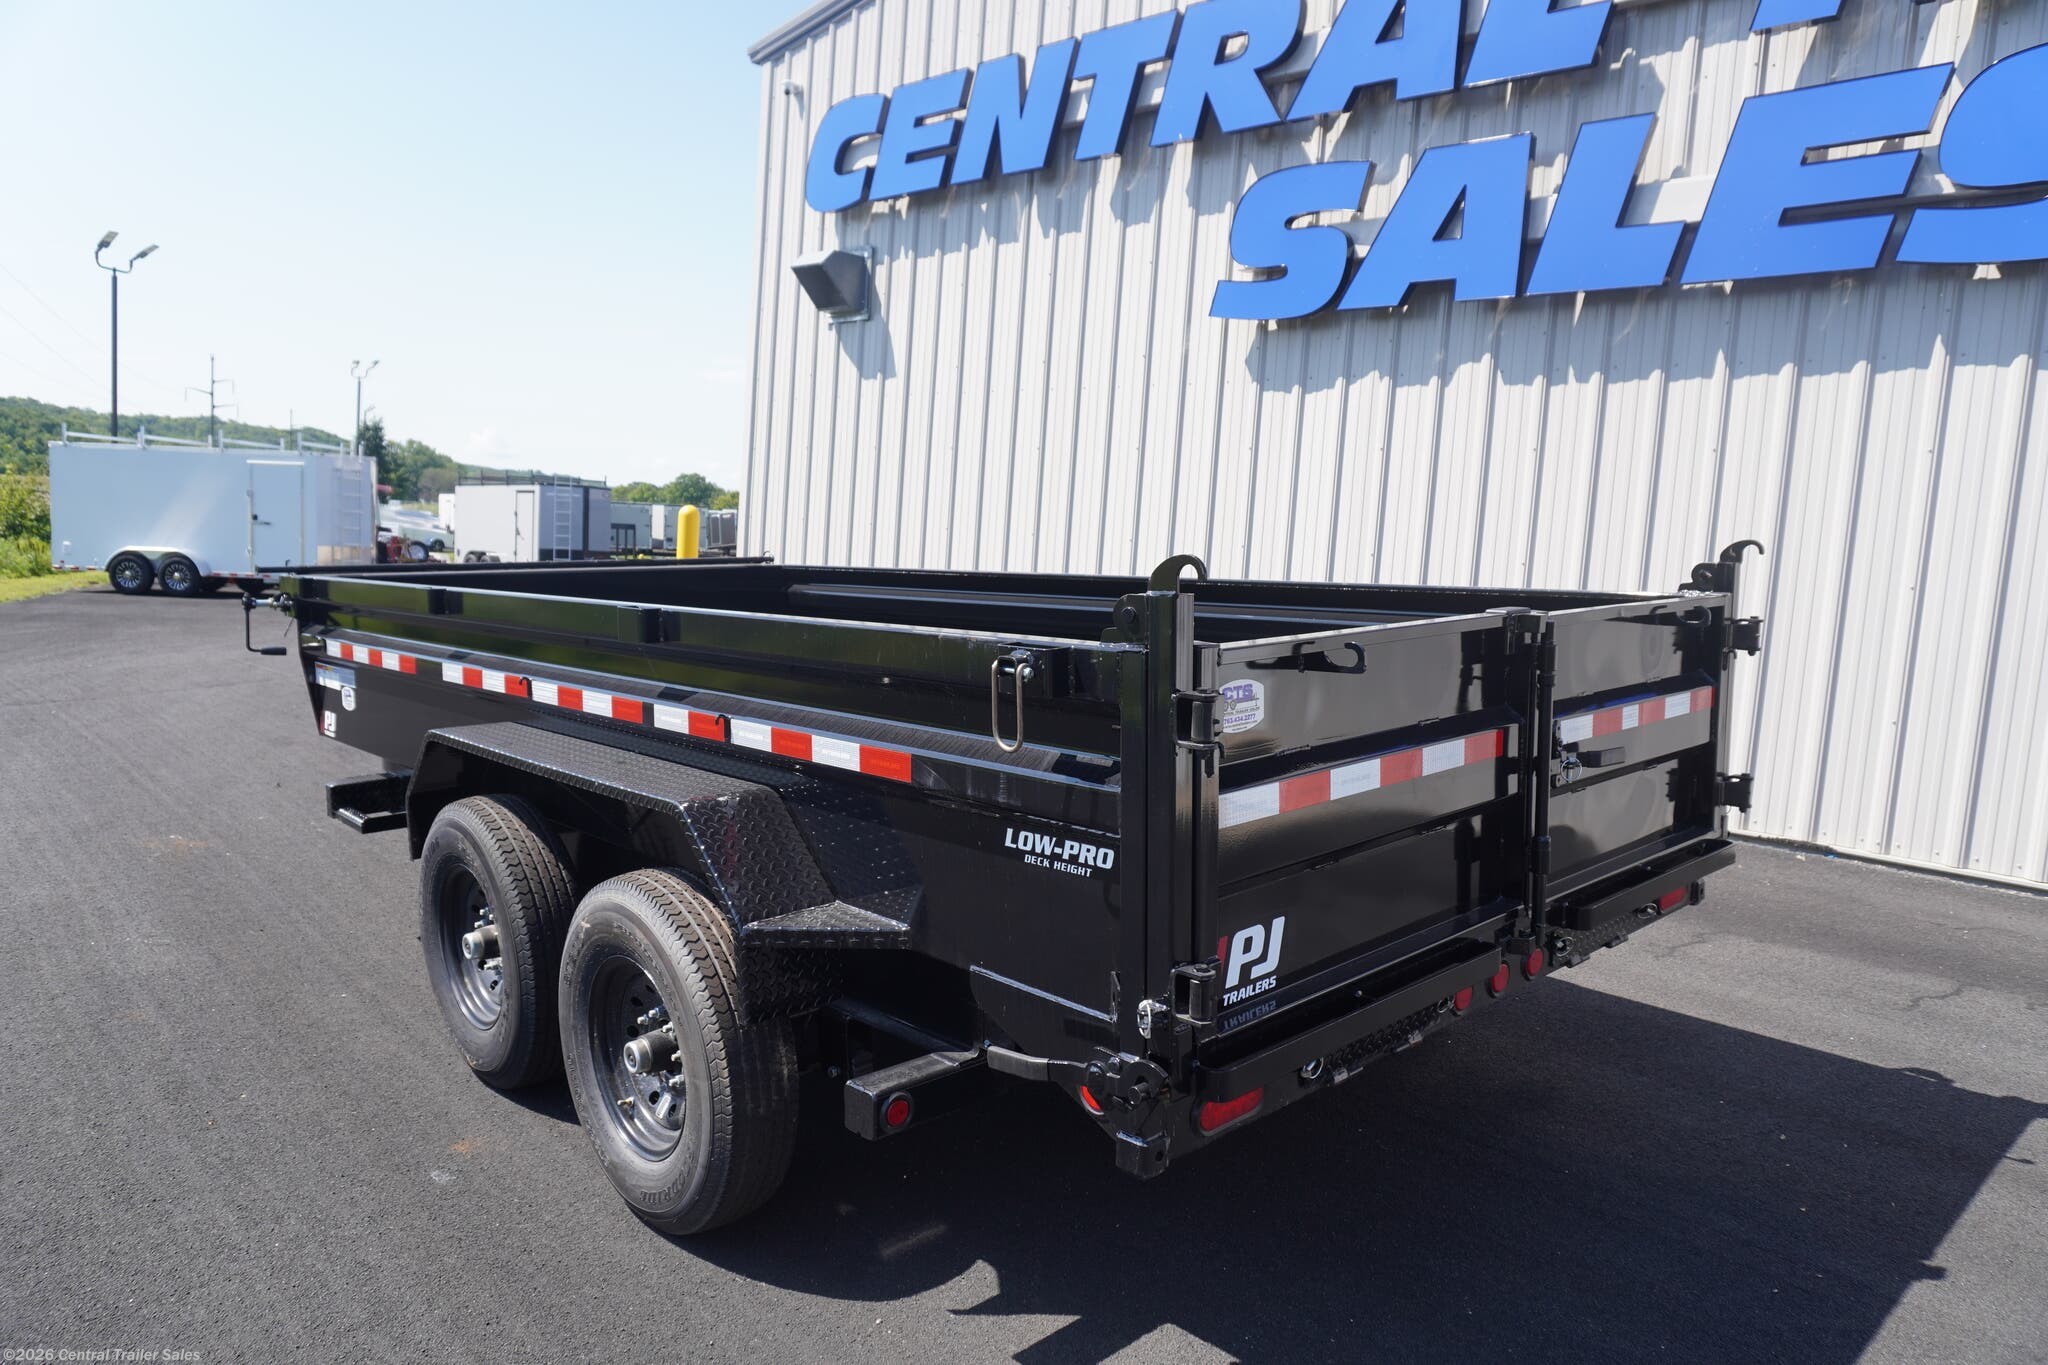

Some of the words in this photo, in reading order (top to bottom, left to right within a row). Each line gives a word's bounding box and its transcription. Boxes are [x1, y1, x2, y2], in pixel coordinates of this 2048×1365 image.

[805, 0, 1614, 213] CENTRAL
[1223, 683, 1254, 701] CTS
[1004, 828, 1115, 870] LOW-PRO
[1024, 854, 1050, 868] DECK
[1053, 860, 1093, 878] HEIGHT
[1225, 916, 1285, 989] PJ
[1223, 975, 1277, 1007] TRAILERS
